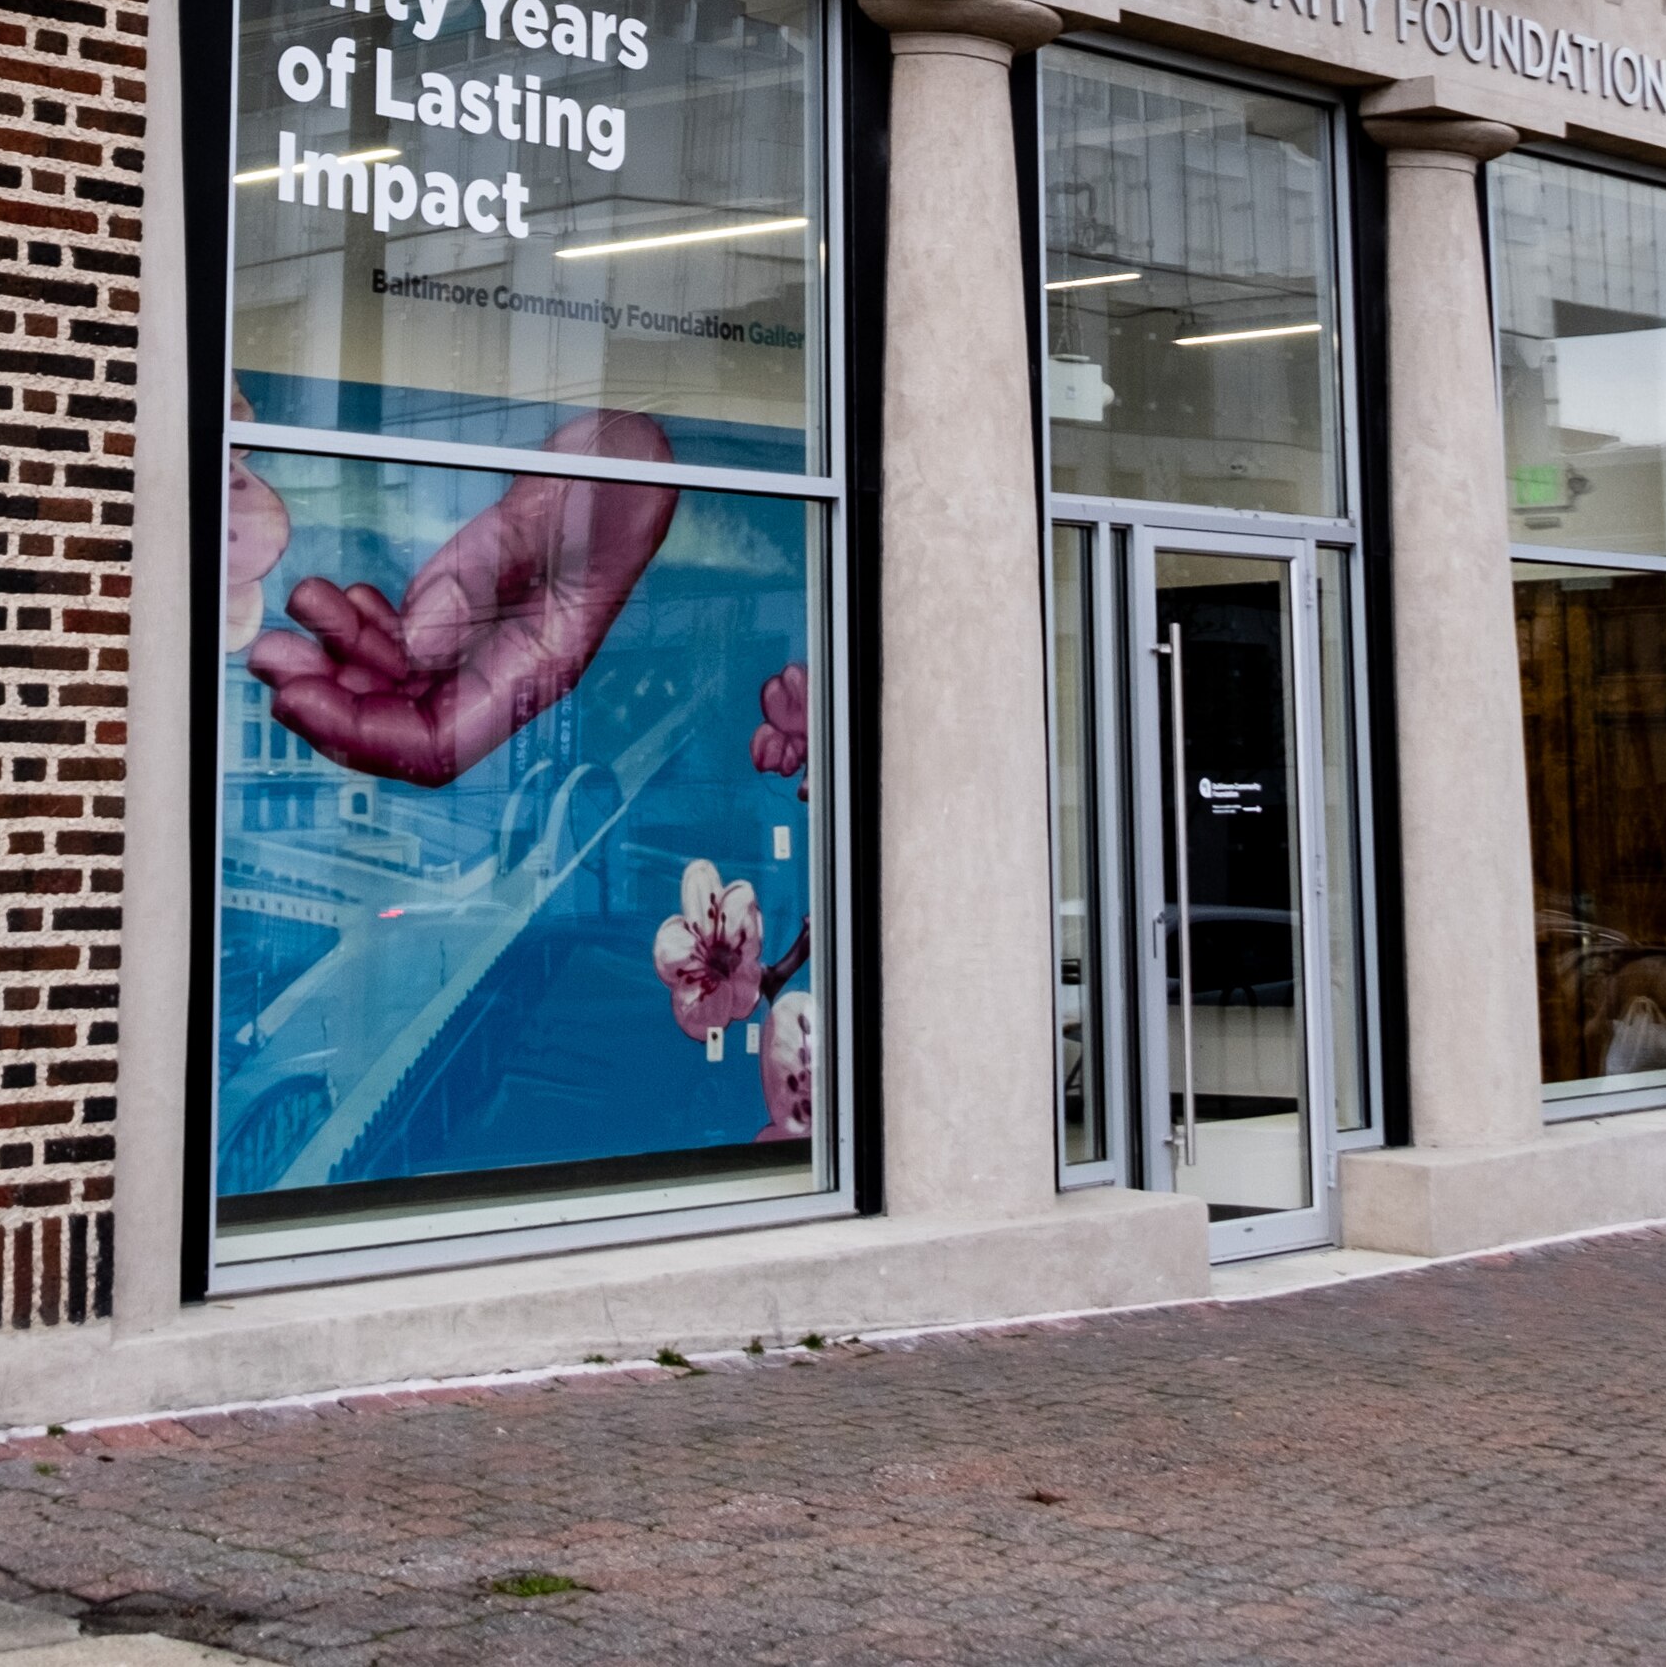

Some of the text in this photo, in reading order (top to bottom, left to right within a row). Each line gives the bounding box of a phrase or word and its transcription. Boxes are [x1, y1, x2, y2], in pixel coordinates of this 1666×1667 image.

[278, 37, 625, 171] of Lasting
[278, 130, 530, 239] Impact
[371, 268, 489, 309] Baltimore
[493, 285, 622, 330] Community
[626, 303, 745, 343] Foundation
